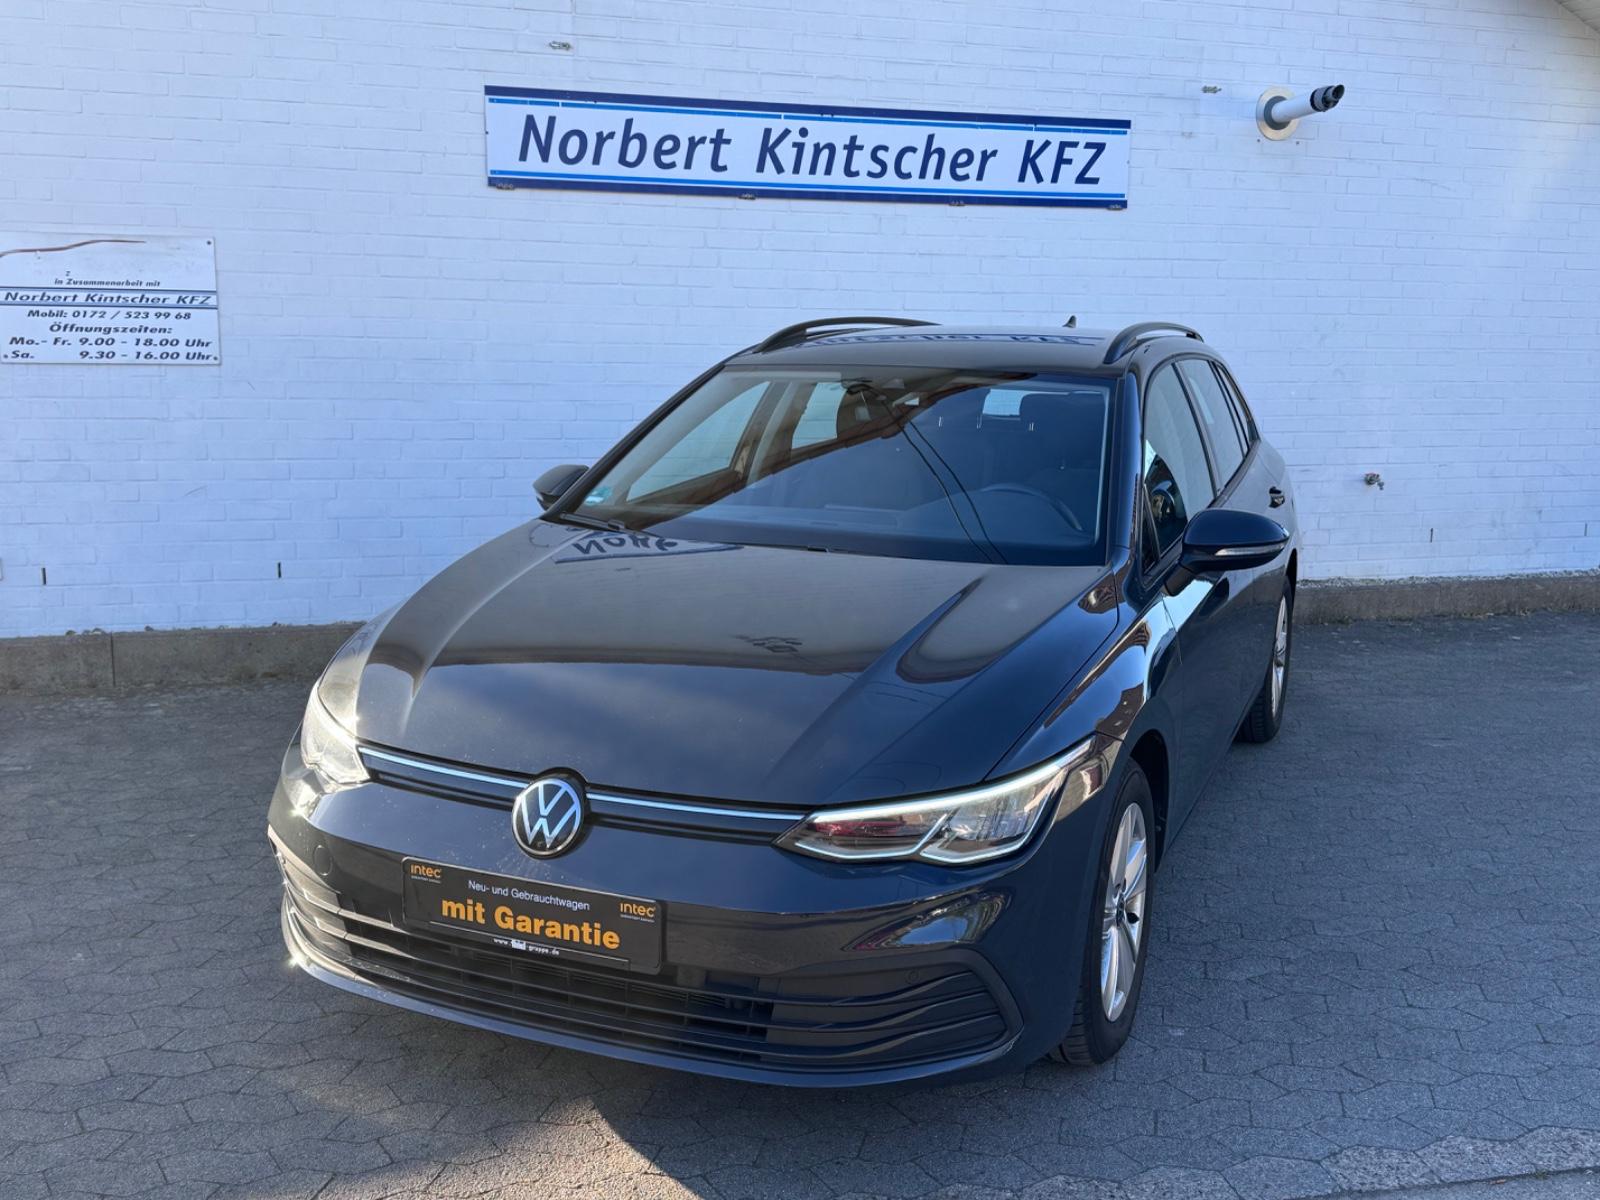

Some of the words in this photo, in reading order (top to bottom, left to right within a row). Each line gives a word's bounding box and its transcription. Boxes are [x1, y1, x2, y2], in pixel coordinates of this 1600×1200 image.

[518, 113, 732, 173] Norbert
[755, 127, 998, 182] Kintscher
[1017, 139, 1107, 185] KFZ
[54, 278, 63, 286] in
[66, 278, 143, 287] Zusammenarbeit
[145, 279, 161, 287] mit
[4, 292, 78, 302] Norbert
[85, 293, 170, 304] Kintscher
[176, 295, 212, 305] KFZ
[27, 309, 68, 318] Mobil:
[72, 310, 107, 319] 0172
[110, 311, 121, 320] /
[124, 311, 150, 320] 523
[154, 312, 171, 320] 99
[174, 312, 192, 320] 68
[49, 321, 173, 335] Öffnungszeiten:
[52, 337, 72, 346] Fr.
[79, 337, 116, 346] 9.00
[135, 338, 180, 347] 18.00
[184, 339, 212, 347] Uhr
[11, 350, 35, 359] Sa.
[79, 350, 116, 360] 9.30
[135, 351, 180, 360] 16.00
[516, 780, 580, 850] VW
[410, 864, 442, 878] intec
[468, 880, 490, 893] Neu-
[491, 885, 509, 897] und
[511, 888, 590, 911] Gebrauchtwagen
[620, 902, 656, 918] intec
[441, 898, 486, 925] mit
[494, 905, 621, 950] Garantie
